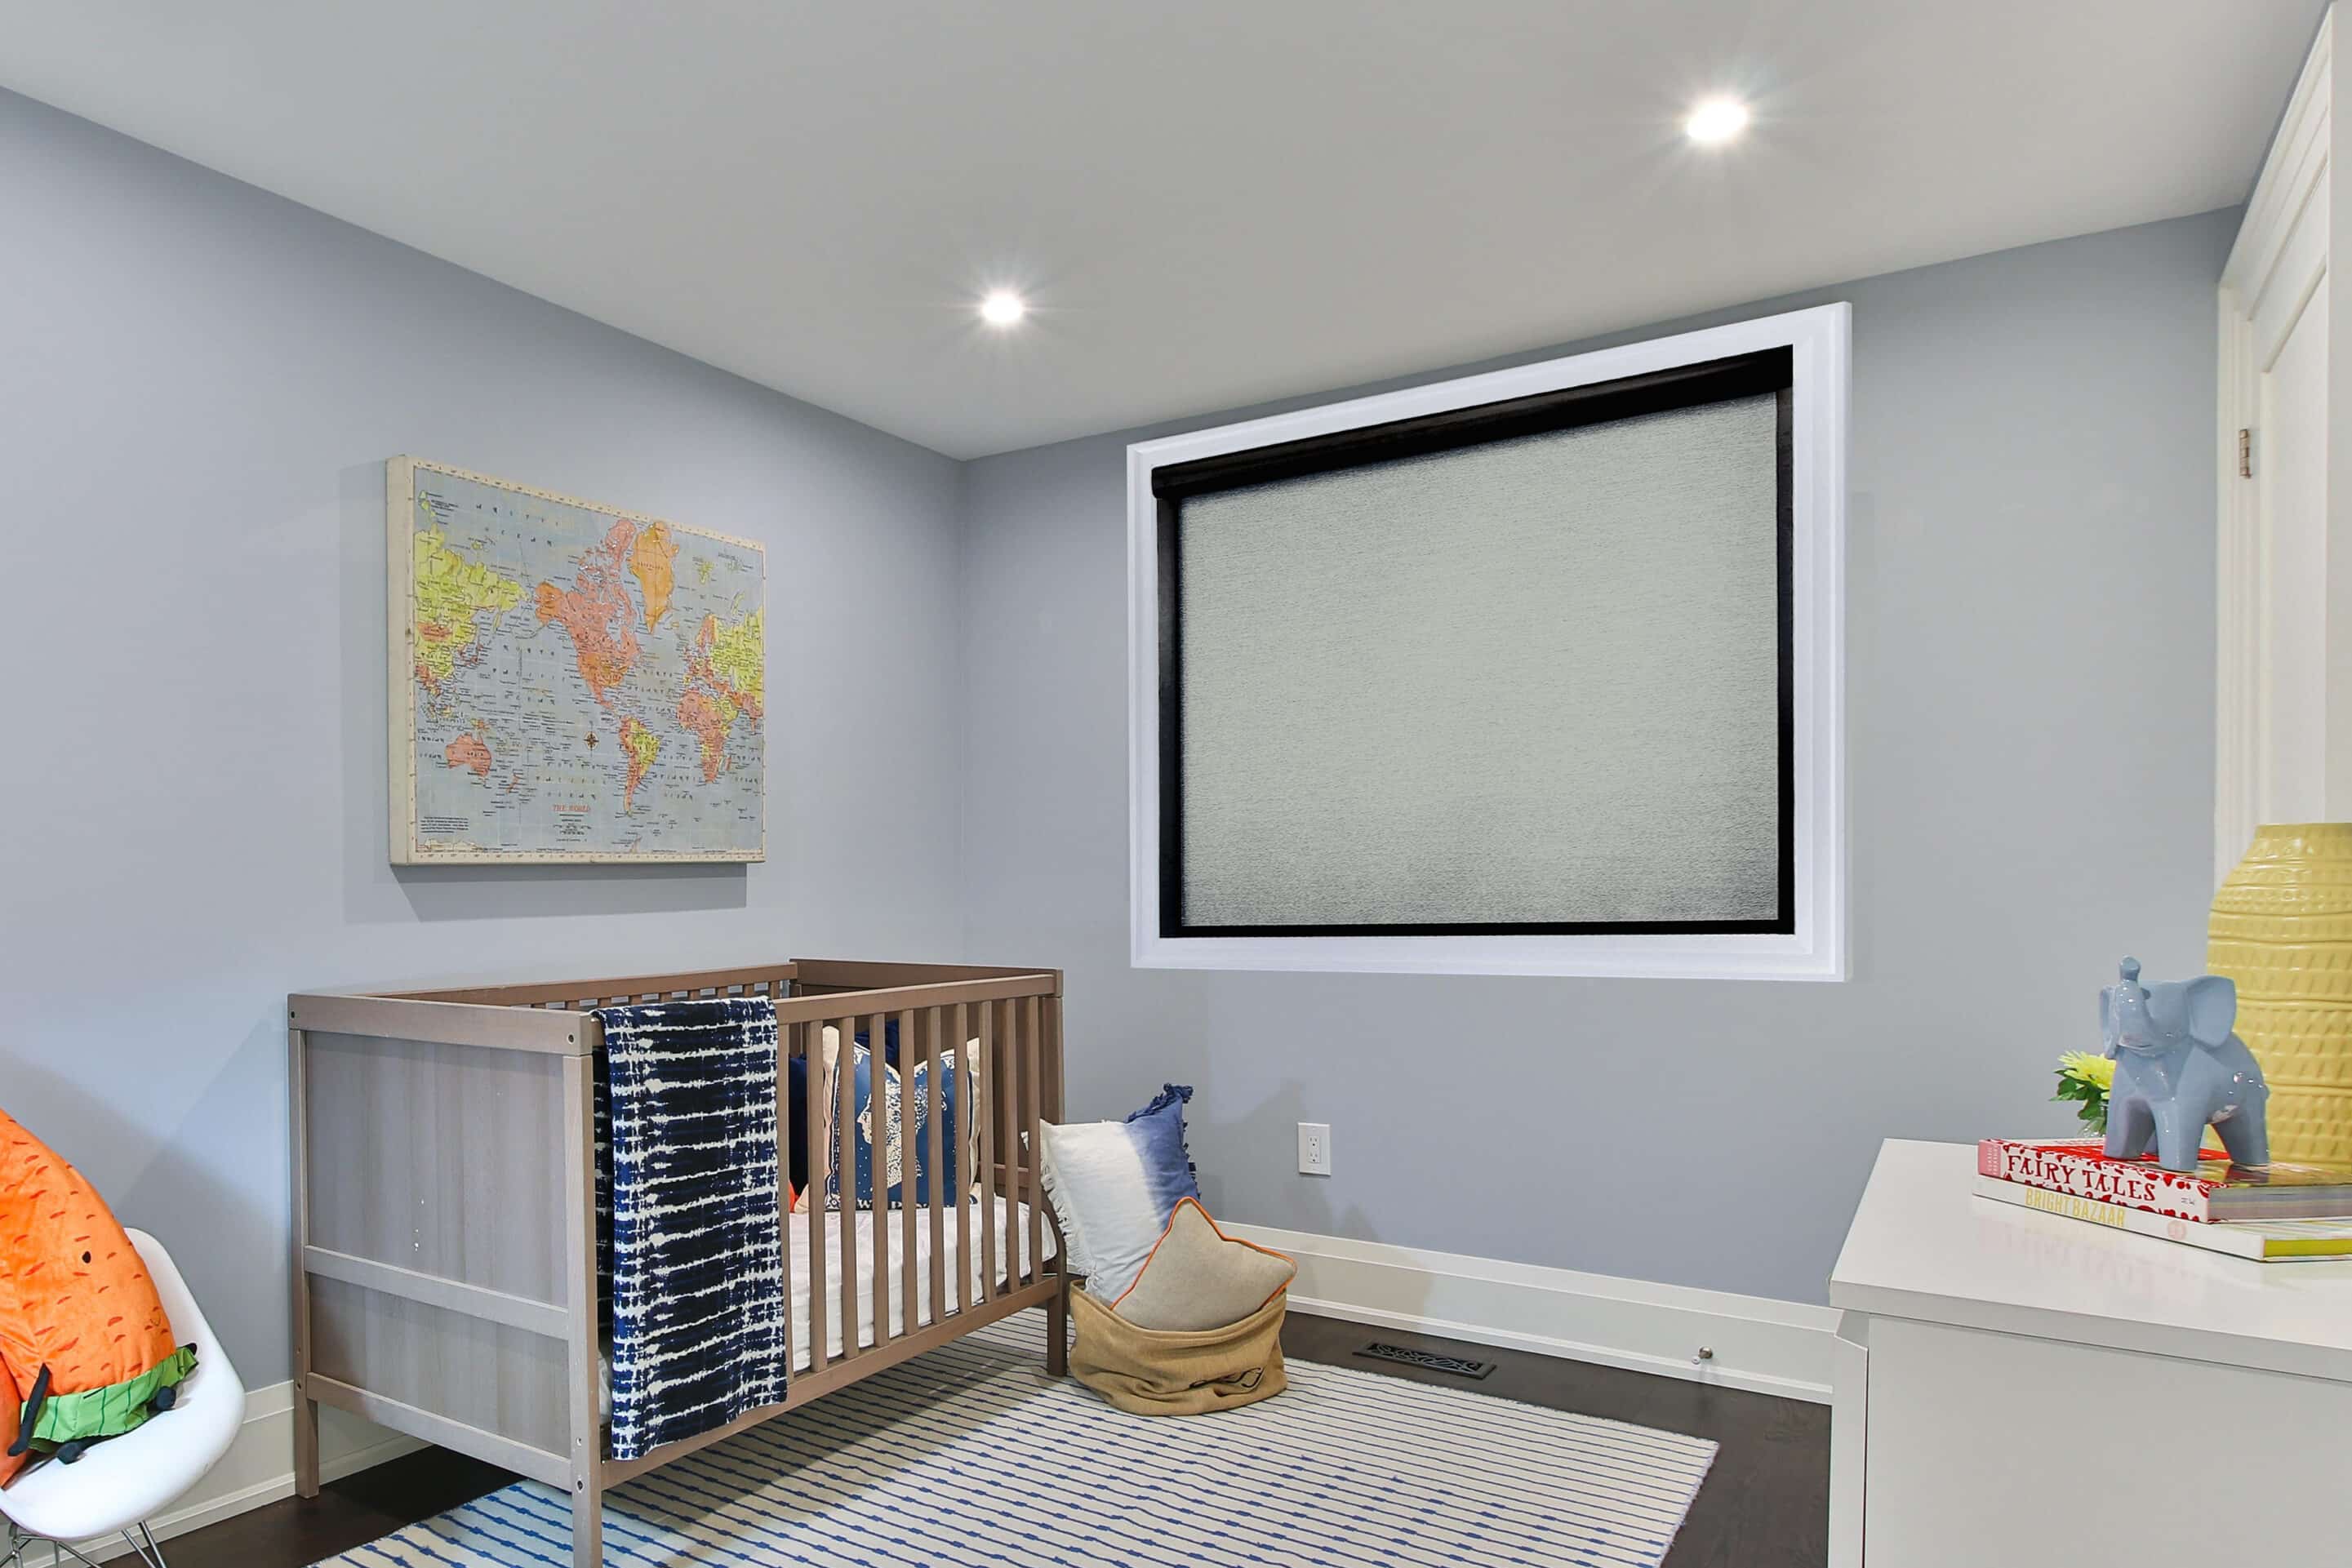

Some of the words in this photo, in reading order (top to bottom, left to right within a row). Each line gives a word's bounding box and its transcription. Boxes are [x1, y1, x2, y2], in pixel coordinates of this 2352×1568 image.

[2007, 1155, 2075, 1184] FAIRY
[2083, 1170, 2156, 1201] TALES
[2025, 1188, 2071, 1213] BRIGHT
[2073, 1200, 2126, 1228] BAZAAR
